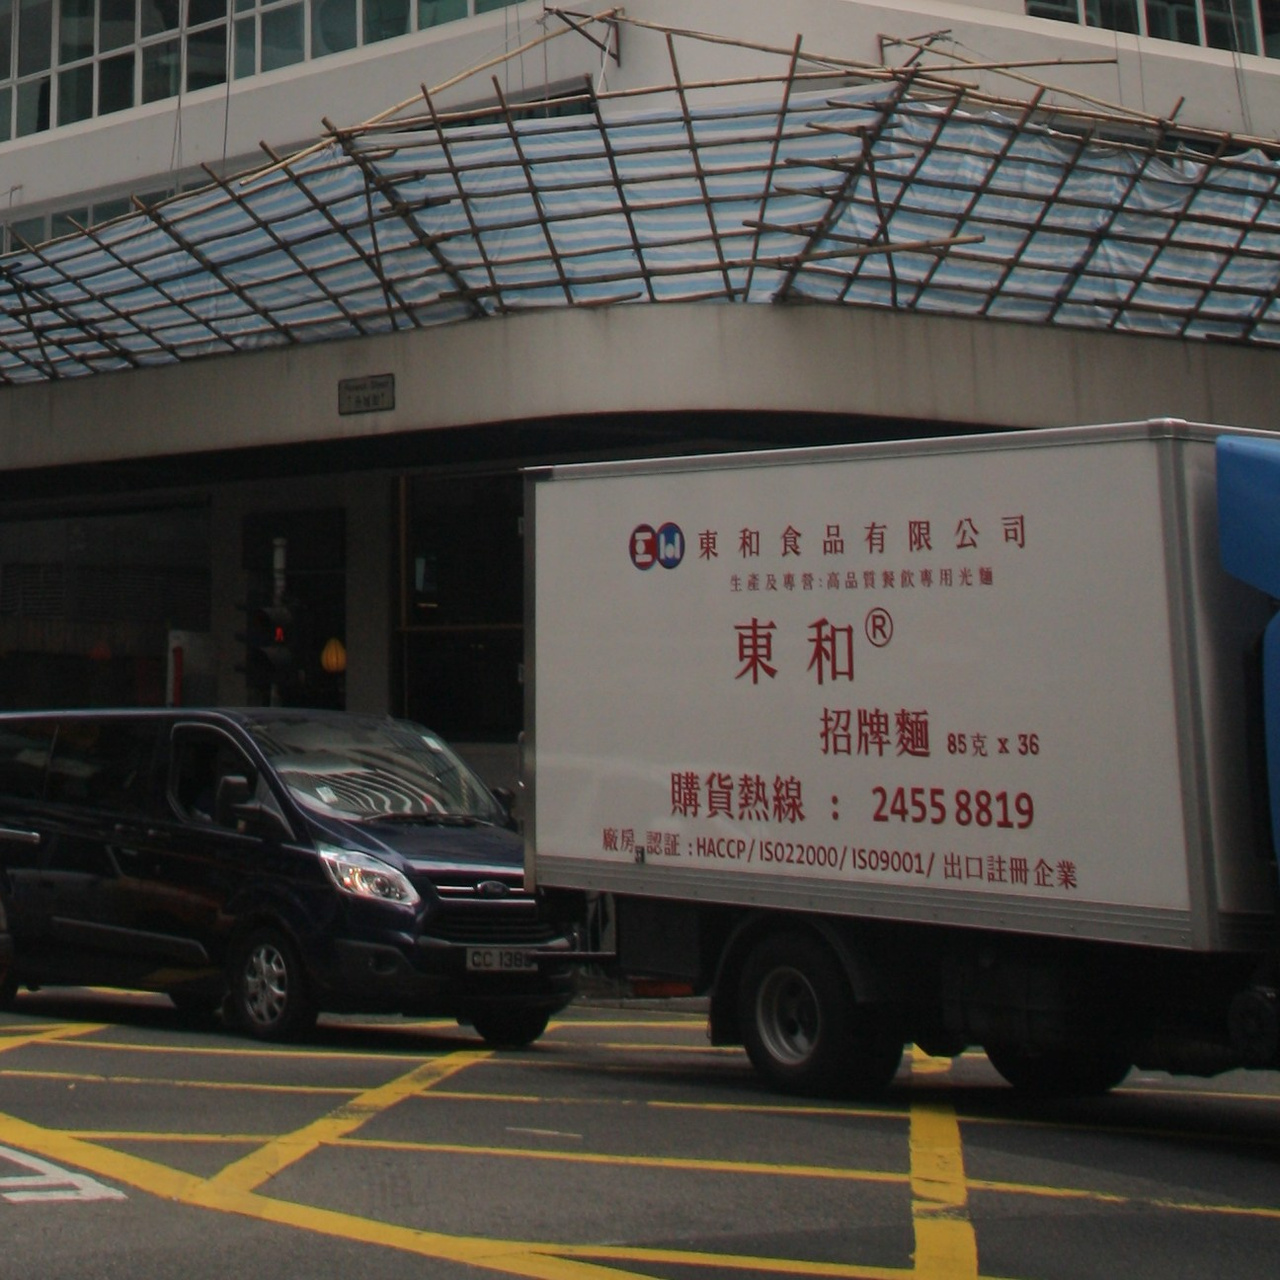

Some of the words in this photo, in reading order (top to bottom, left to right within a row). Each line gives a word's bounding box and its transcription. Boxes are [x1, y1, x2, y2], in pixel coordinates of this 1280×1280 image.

[697, 513, 1027, 561] 東和食品有限公司
[819, 707, 931, 758] 招牌麵
[1017, 732, 1040, 756] 36
[669, 770, 806, 823] 購貨熱線
[871, 785, 947, 825] 2455
[954, 788, 1035, 830] 8819
[472, 951, 493, 967] CC
